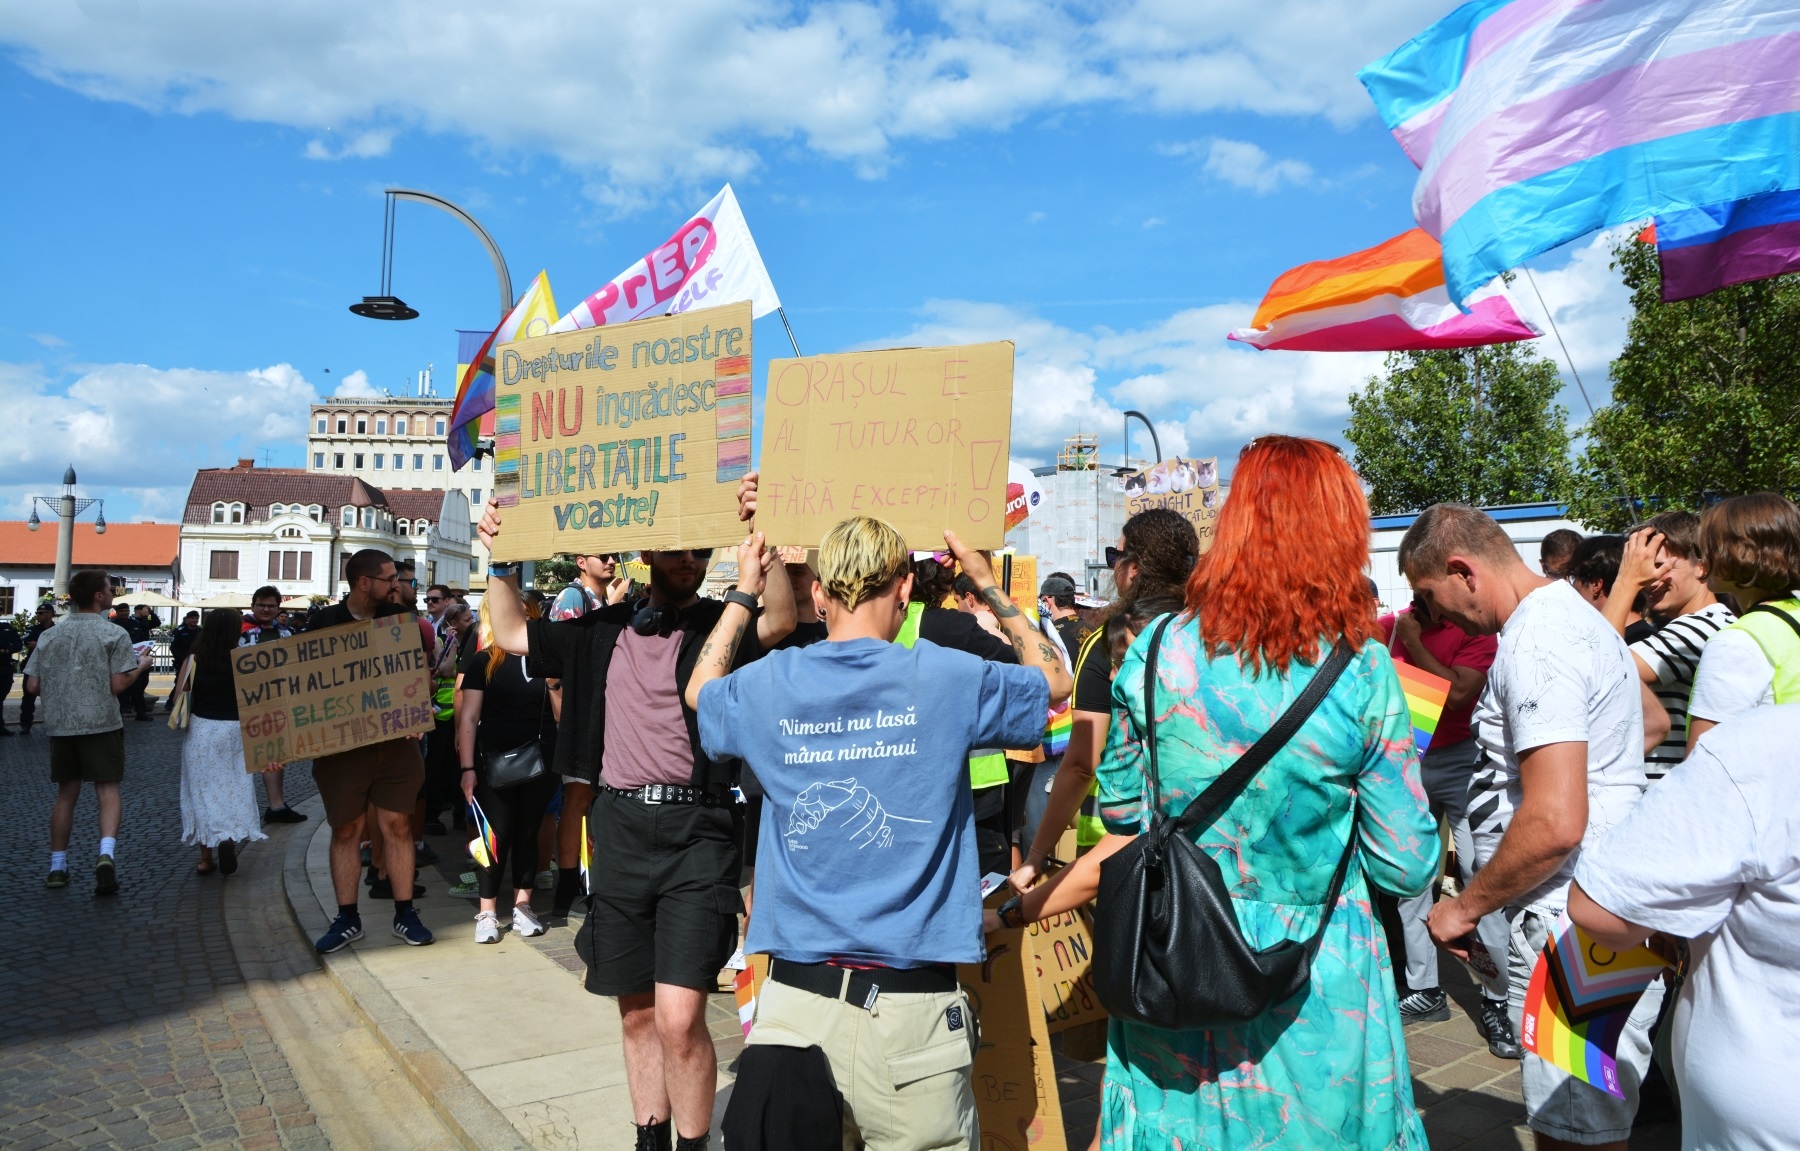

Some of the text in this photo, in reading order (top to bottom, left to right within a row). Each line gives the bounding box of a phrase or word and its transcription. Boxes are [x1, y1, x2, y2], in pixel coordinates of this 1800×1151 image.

[503, 324, 743, 386] Drepturile noastre
[776, 360, 969, 409] ORAȘUL E
[532, 378, 717, 441] NU îngrădesc
[773, 418, 965, 453] AL TUTUROR
[554, 490, 659, 531] voastre!
[768, 474, 834, 518] FĂRĂ
[236, 630, 369, 675] GOD HELP YOU
[241, 648, 424, 706] WITH ALL THIS HATE
[245, 686, 392, 738] GOD BLESS ME
[779, 705, 918, 736] Nimeni nu lasă
[253, 736, 287, 766] FOR
[296, 726, 336, 755] ALL
[333, 715, 379, 745] THIS
[784, 738, 918, 765] mâna nimănui
[1053, 933, 1088, 971] NU
